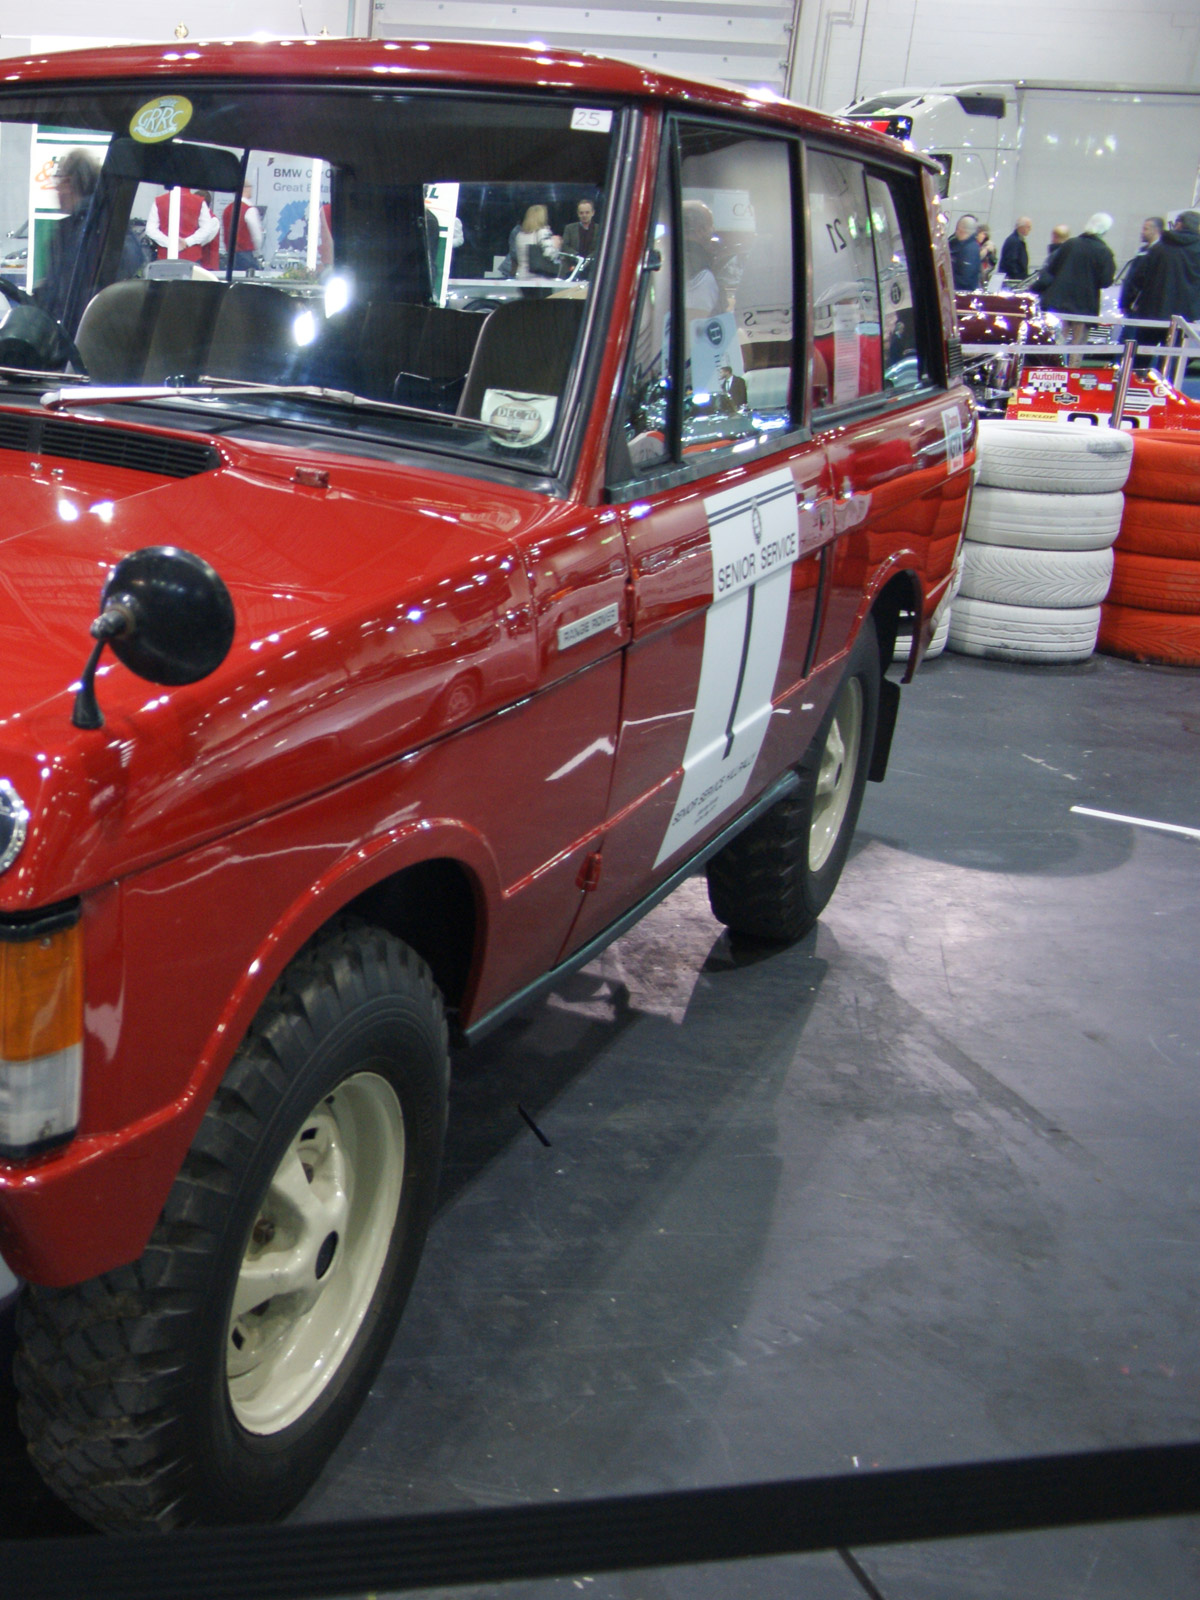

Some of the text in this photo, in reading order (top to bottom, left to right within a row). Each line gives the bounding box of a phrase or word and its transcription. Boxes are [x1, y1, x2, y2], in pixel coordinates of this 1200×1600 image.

[138, 107, 184, 132] GRRC
[574, 111, 600, 126] 25
[273, 168, 302, 178] BMW
[273, 182, 304, 193] Great
[1031, 367, 1066, 380] Autolite
[718, 532, 796, 592] SENIOR SERVICE
